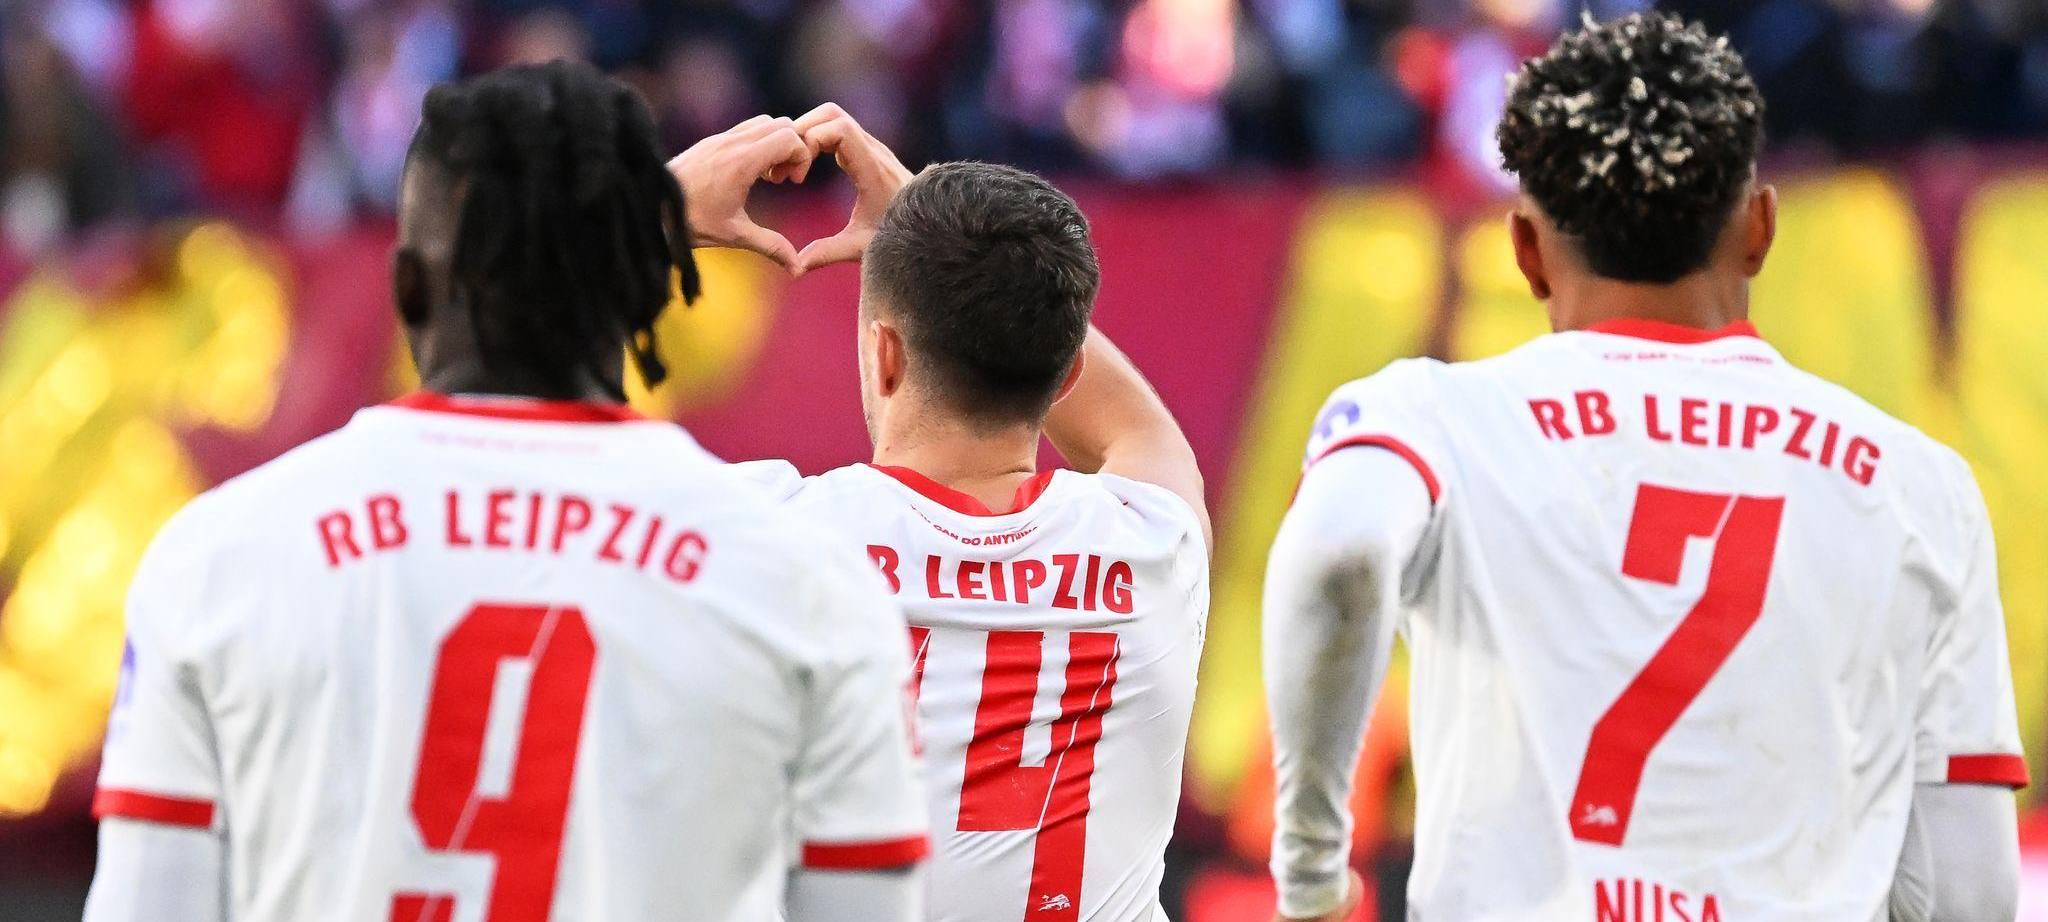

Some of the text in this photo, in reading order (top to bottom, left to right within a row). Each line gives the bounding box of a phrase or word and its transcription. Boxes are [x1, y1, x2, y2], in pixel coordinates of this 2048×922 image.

[1527, 390, 1882, 487] RB LEIPZIG
[316, 489, 709, 584] RB LEIPZIG
[932, 523, 959, 541] CAN
[961, 536, 981, 546] DO
[925, 553, 1134, 614] LEIPZIG
[1568, 483, 1786, 848] 7
[388, 600, 599, 922] 9
[906, 626, 1121, 922] 4
